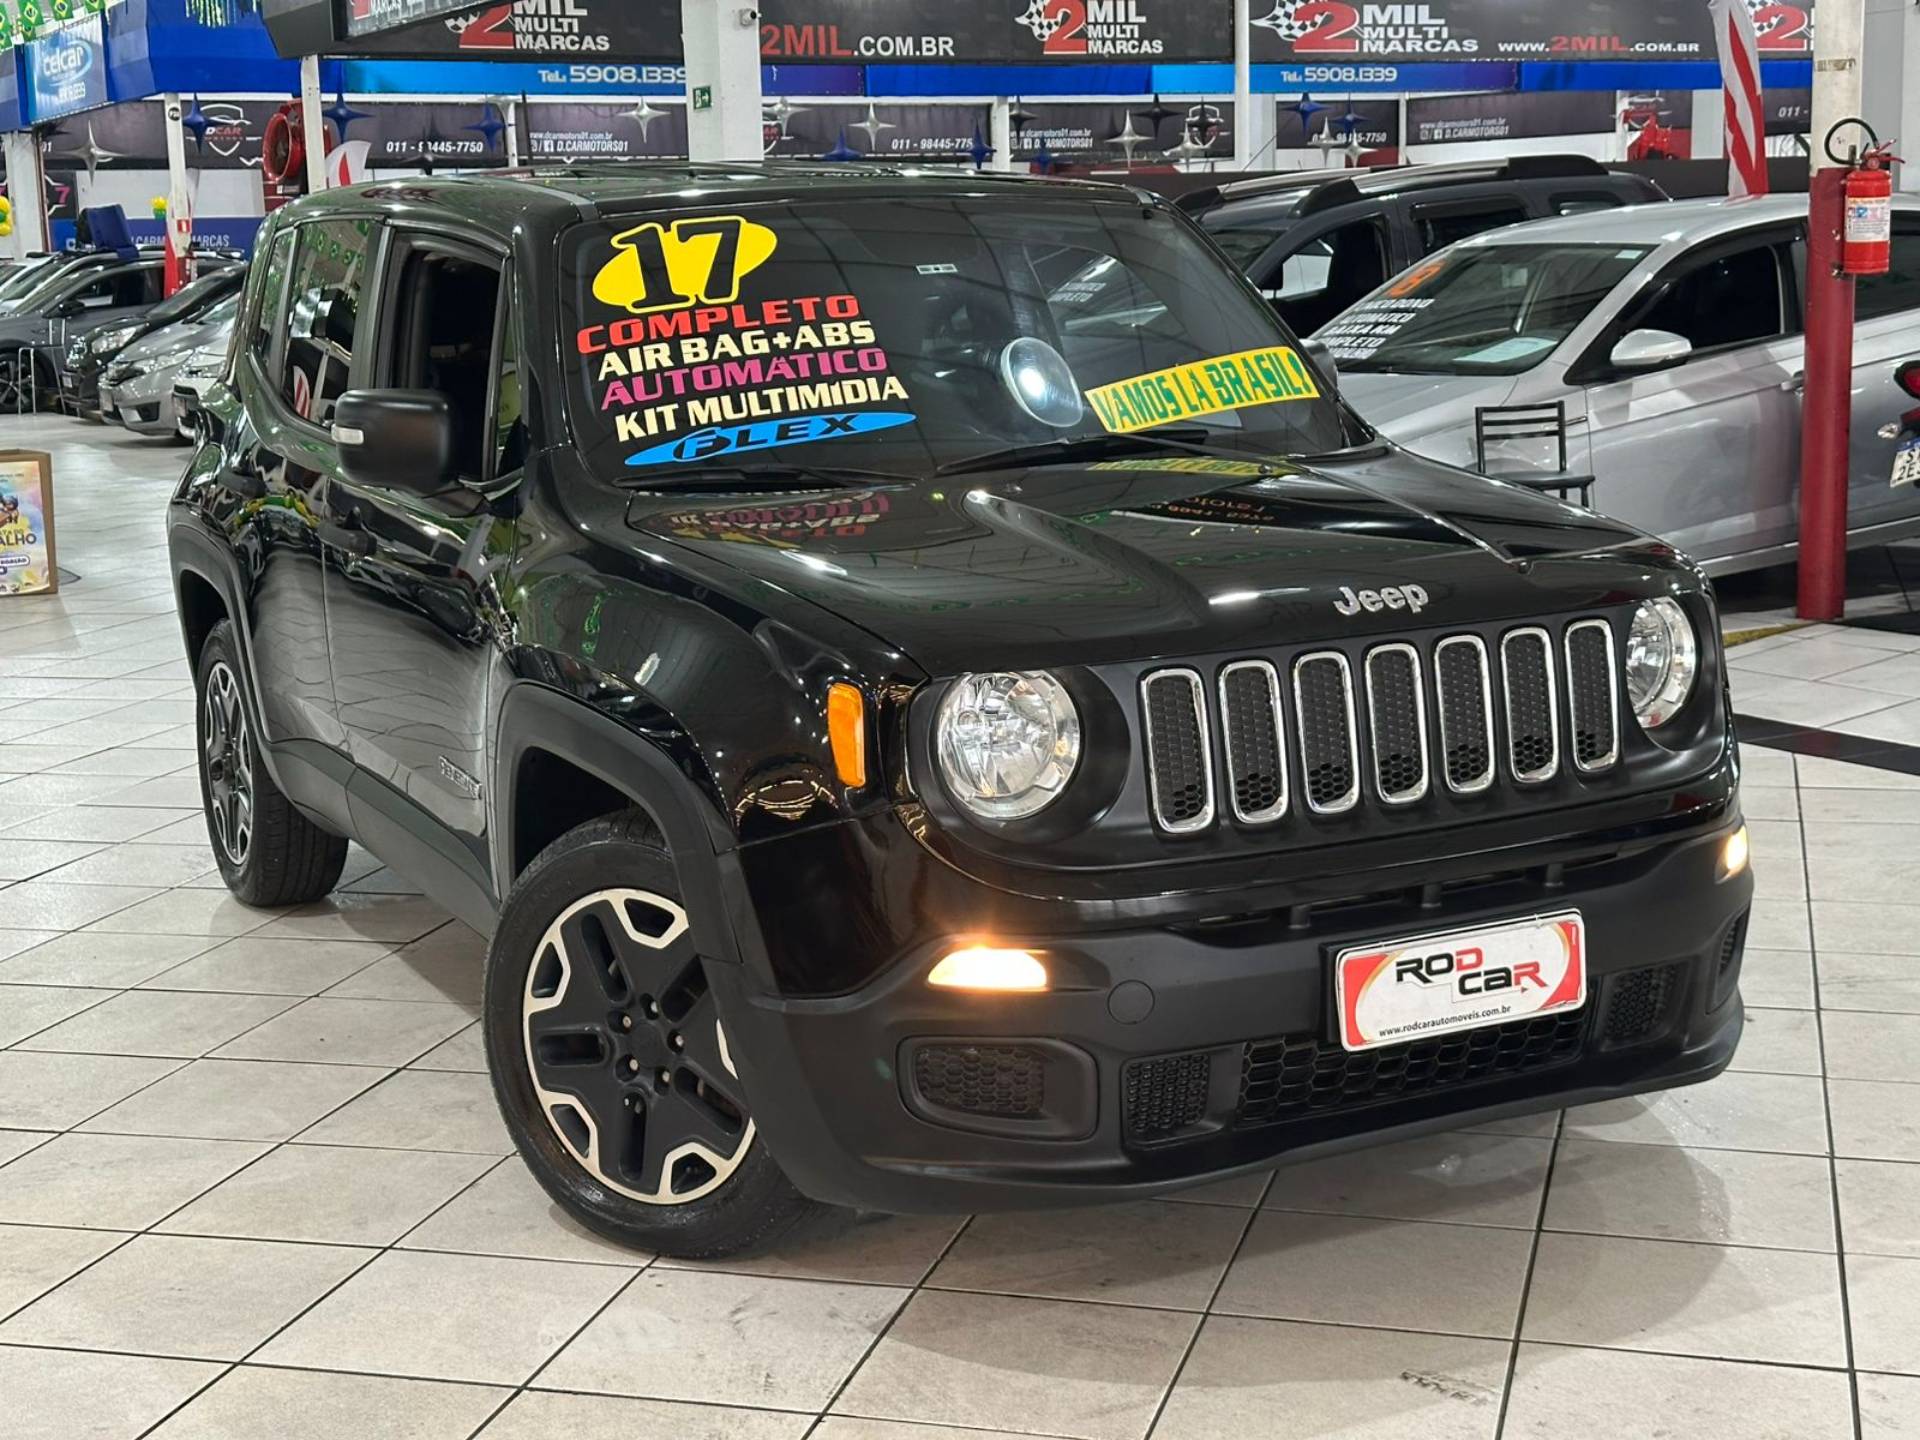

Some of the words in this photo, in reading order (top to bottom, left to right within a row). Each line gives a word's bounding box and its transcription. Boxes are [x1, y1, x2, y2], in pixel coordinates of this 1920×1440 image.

[514, 16, 580, 33] MULTI
[1043, 0, 1087, 54] 2
[1087, 0, 1147, 23] MIL
[1087, 25, 1140, 38] MULTI
[1292, 0, 1360, 53] 2
[1362, 4, 1446, 25] MIL
[1362, 26, 1449, 39] MULTI
[514, 34, 610, 51] MARCAS
[1087, 40, 1164, 54] MARCAS
[1362, 39, 1479, 52] MARCAS
[386, 141, 407, 153] 011
[611, 217, 745, 312] 17
[577, 295, 860, 354] COMPLETO
[598, 341, 674, 381] AIR
[680, 320, 877, 365] BAG+ABS
[1092, 373, 1182, 430] VAMOS
[615, 403, 680, 442] KIT
[677, 414, 858, 460] FLEX
[1332, 583, 1430, 616] Jeep
[1395, 947, 1484, 984] ROD
[1378, 1004, 1512, 1038] www.rodcarautomoveis.com.br
